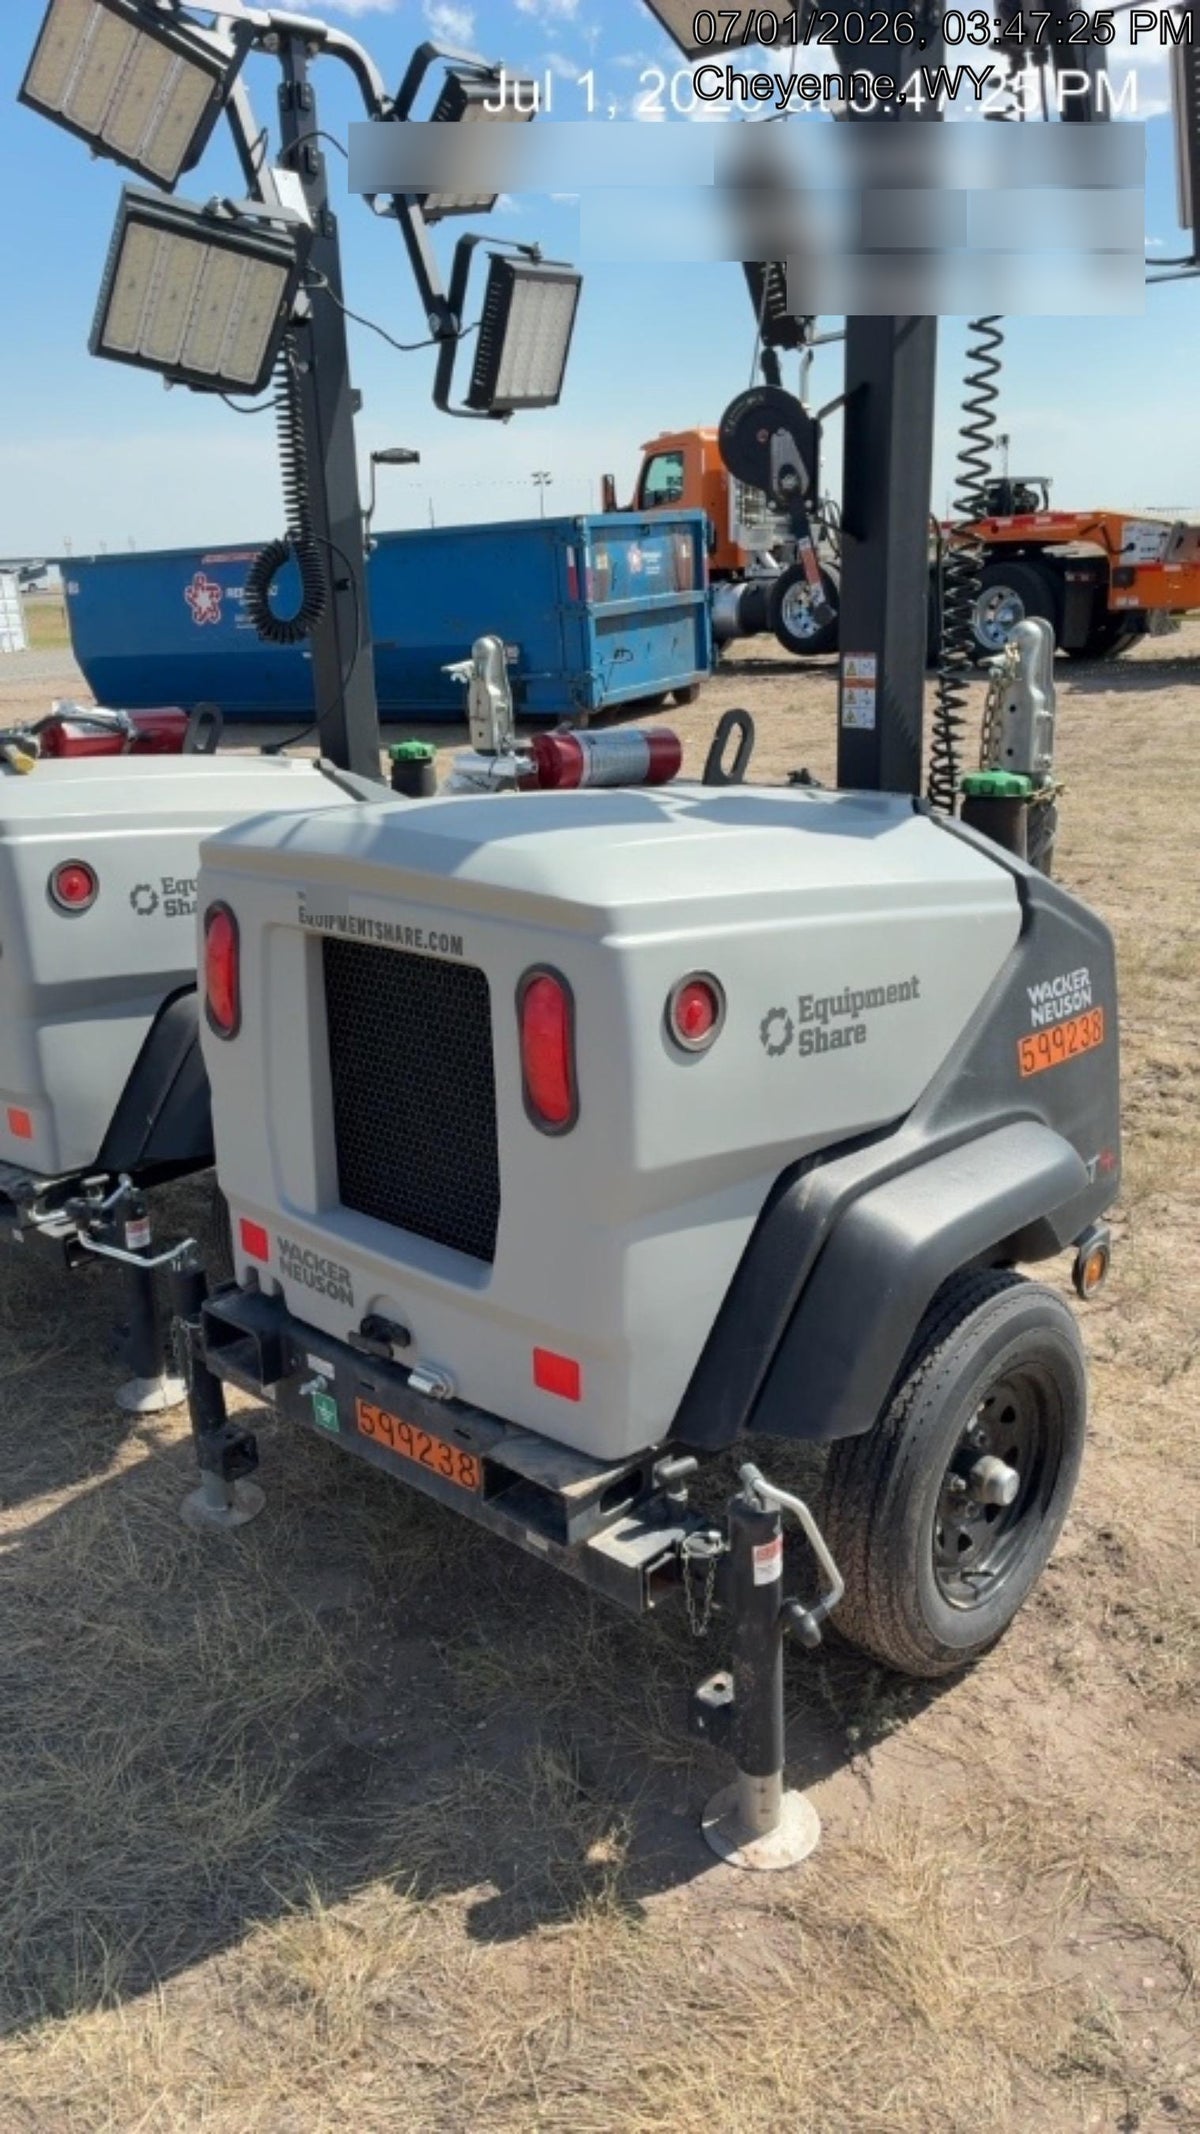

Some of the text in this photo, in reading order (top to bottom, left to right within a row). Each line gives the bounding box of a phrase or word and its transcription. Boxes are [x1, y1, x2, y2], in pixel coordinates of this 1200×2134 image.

[798, 974, 920, 1025] Equipment
[1026, 967, 1091, 1005] WACKER
[1031, 985, 1092, 1027] NEUSON
[798, 1023, 866, 1057] Share
[1021, 1009, 1101, 1073] 599238
[277, 1235, 352, 1289] WACKER
[280, 1256, 354, 1309] NEUSON
[358, 1402, 476, 1489] 599238
